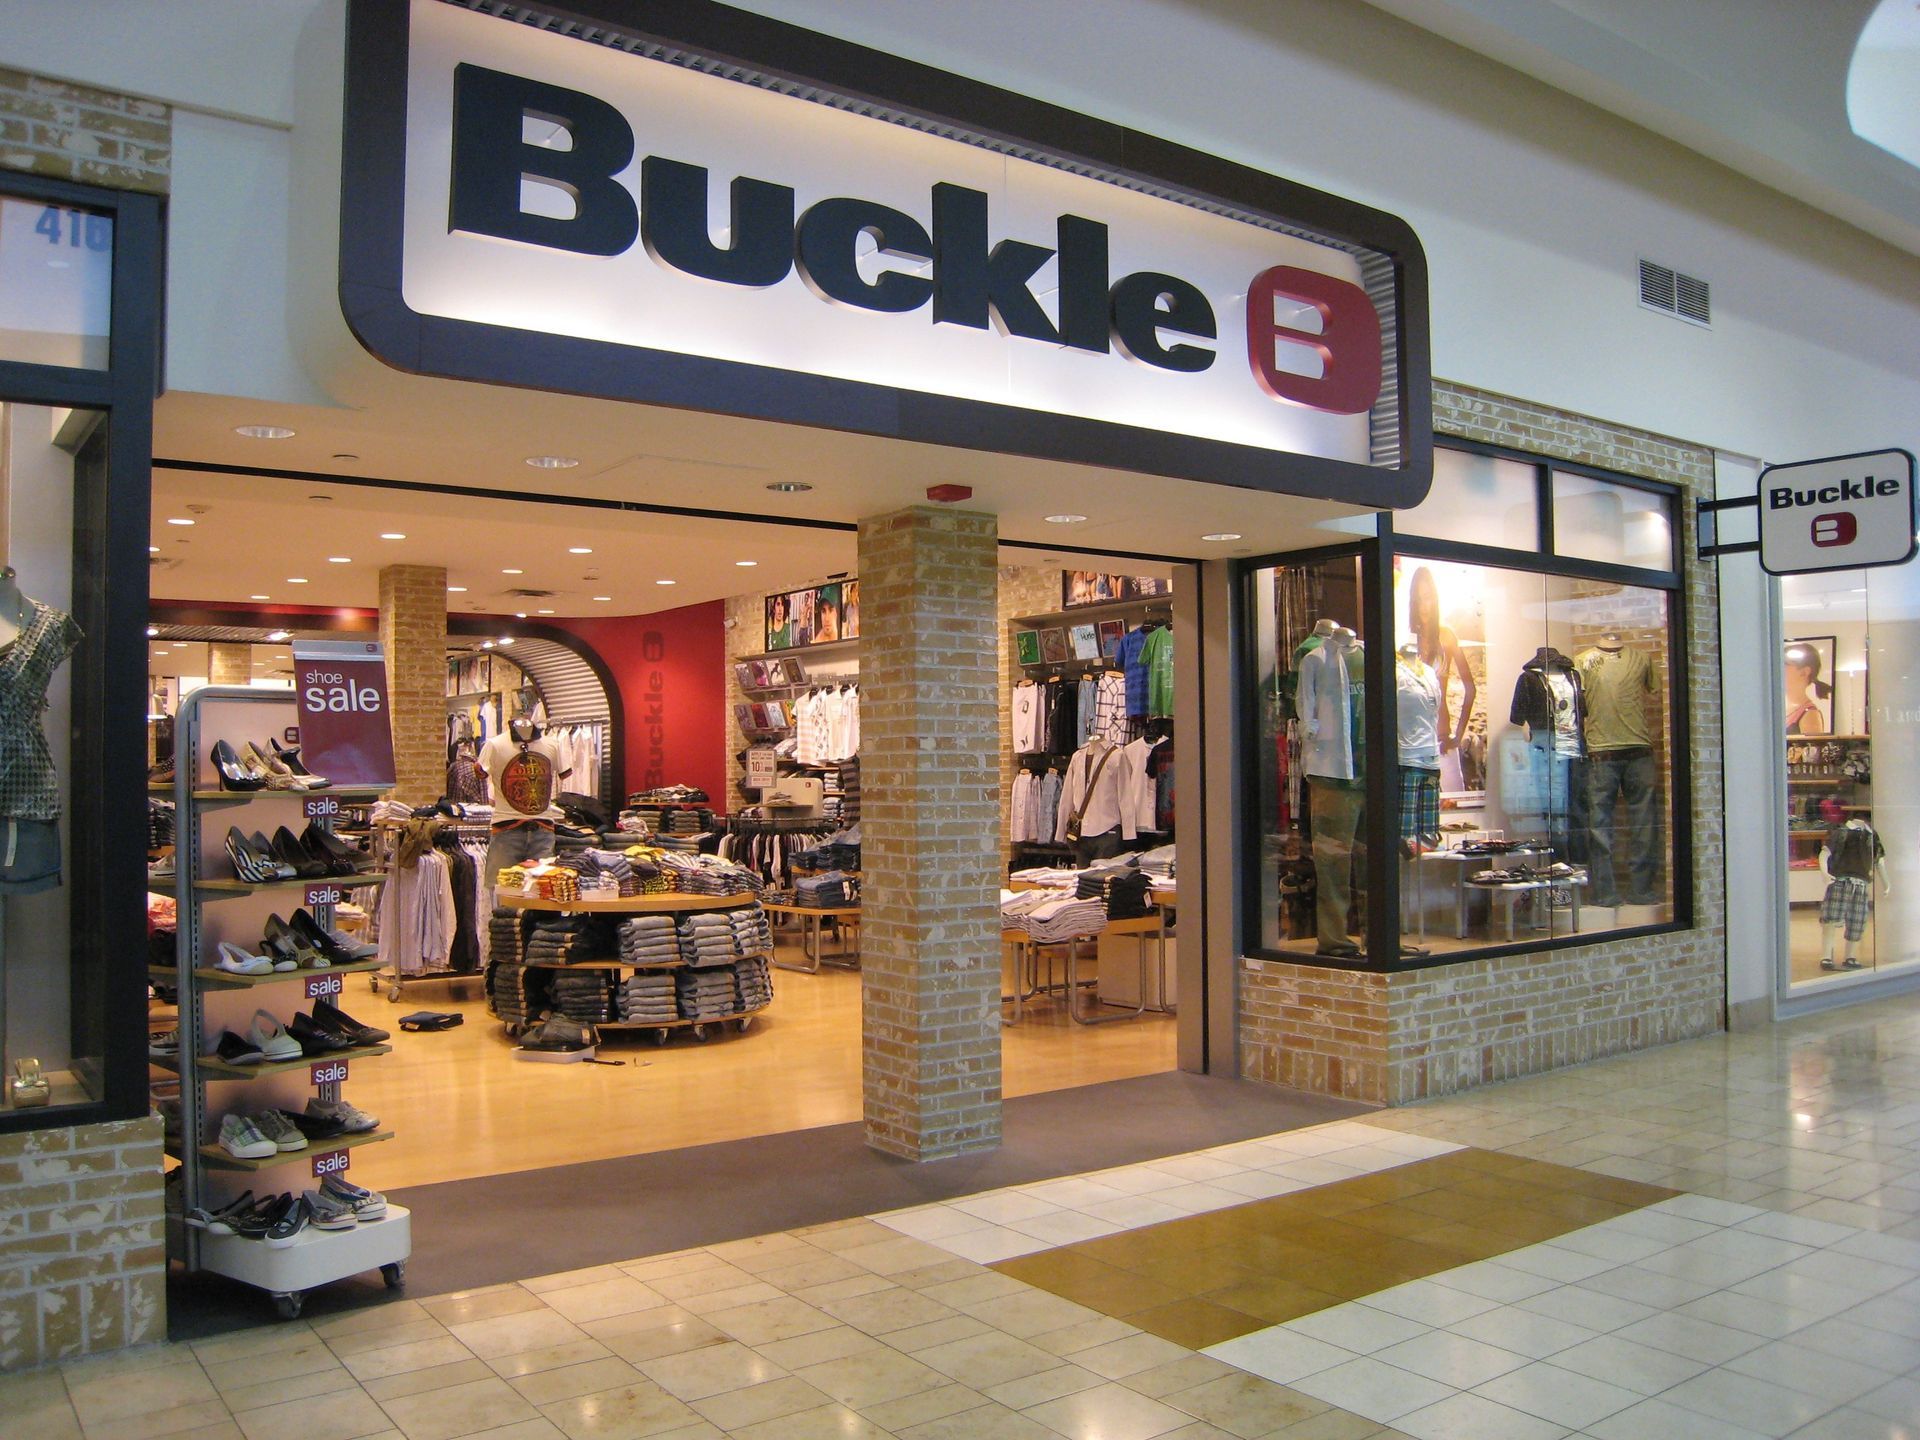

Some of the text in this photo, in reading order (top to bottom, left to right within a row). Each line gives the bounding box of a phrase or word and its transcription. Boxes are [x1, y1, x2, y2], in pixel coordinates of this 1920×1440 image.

[448, 62, 1217, 373] Buckle
[1769, 475, 1900, 510] Buckle
[306, 669, 343, 684] shoe
[305, 678, 380, 712] sale
[307, 797, 339, 815] sale
[309, 885, 340, 904] sale
[309, 976, 341, 996] sale
[315, 1063, 347, 1083] sale
[316, 1153, 348, 1174] sale
